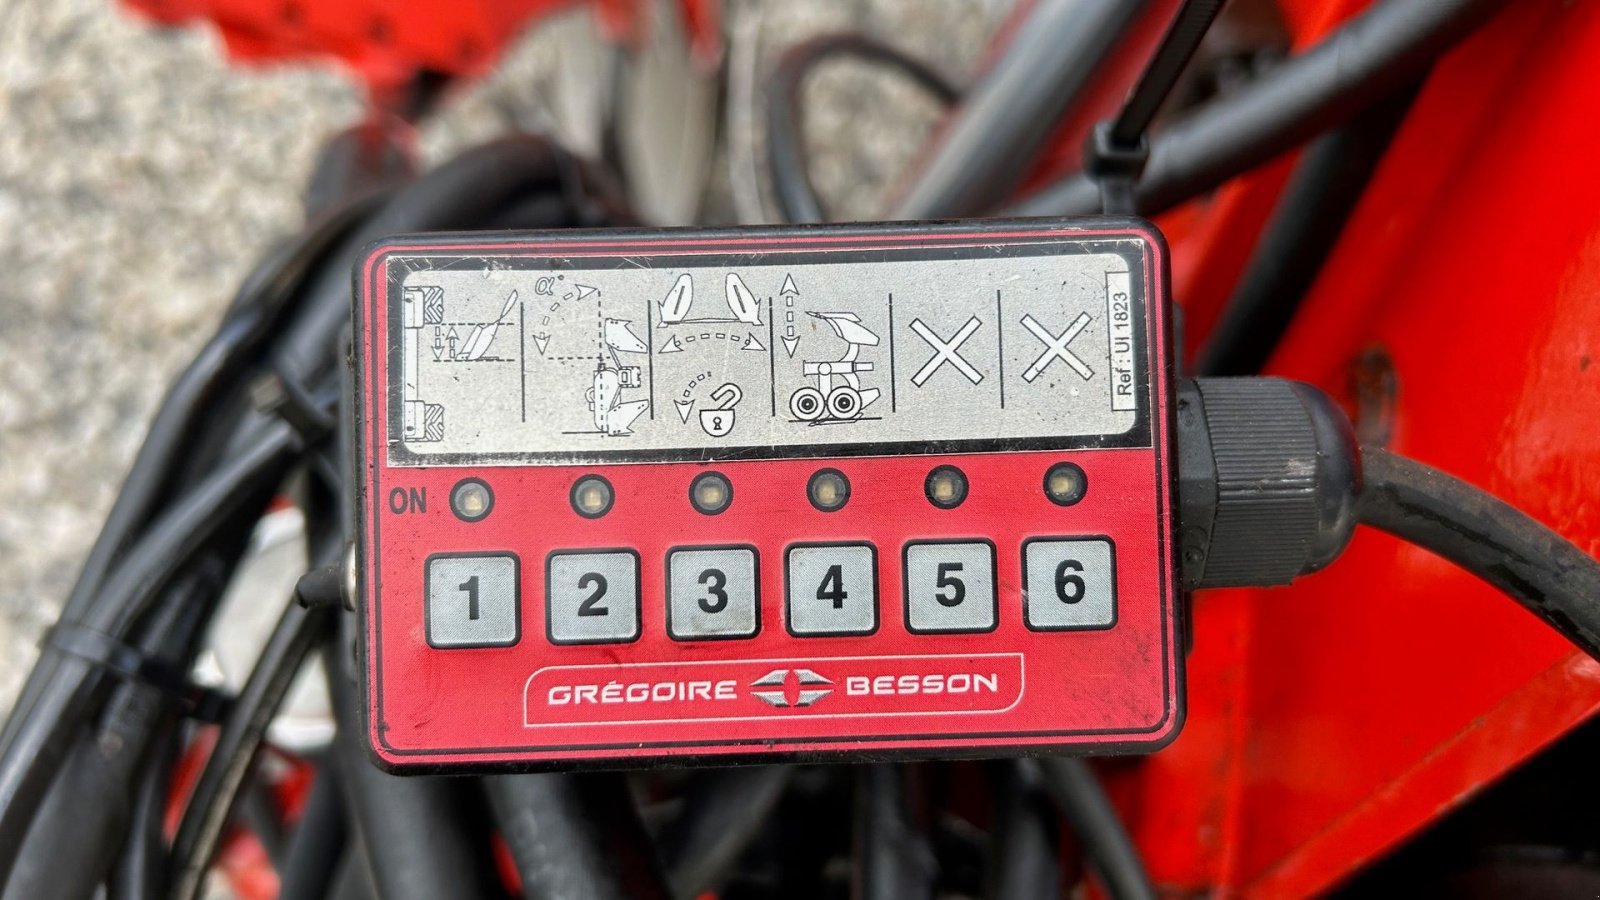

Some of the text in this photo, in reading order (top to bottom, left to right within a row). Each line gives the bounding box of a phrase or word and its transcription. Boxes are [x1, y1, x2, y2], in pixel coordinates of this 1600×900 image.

[1112, 291, 1129, 330] 1823
[1115, 367, 1132, 396] Ref
[388, 486, 427, 515] ON
[458, 575, 480, 621] 1
[577, 572, 609, 617] 2
[697, 568, 729, 614] 3
[816, 564, 848, 609] 4
[934, 562, 966, 607] 5
[1054, 559, 1086, 605] 6
[547, 673, 999, 706] GRÉGOIRE BESSON
